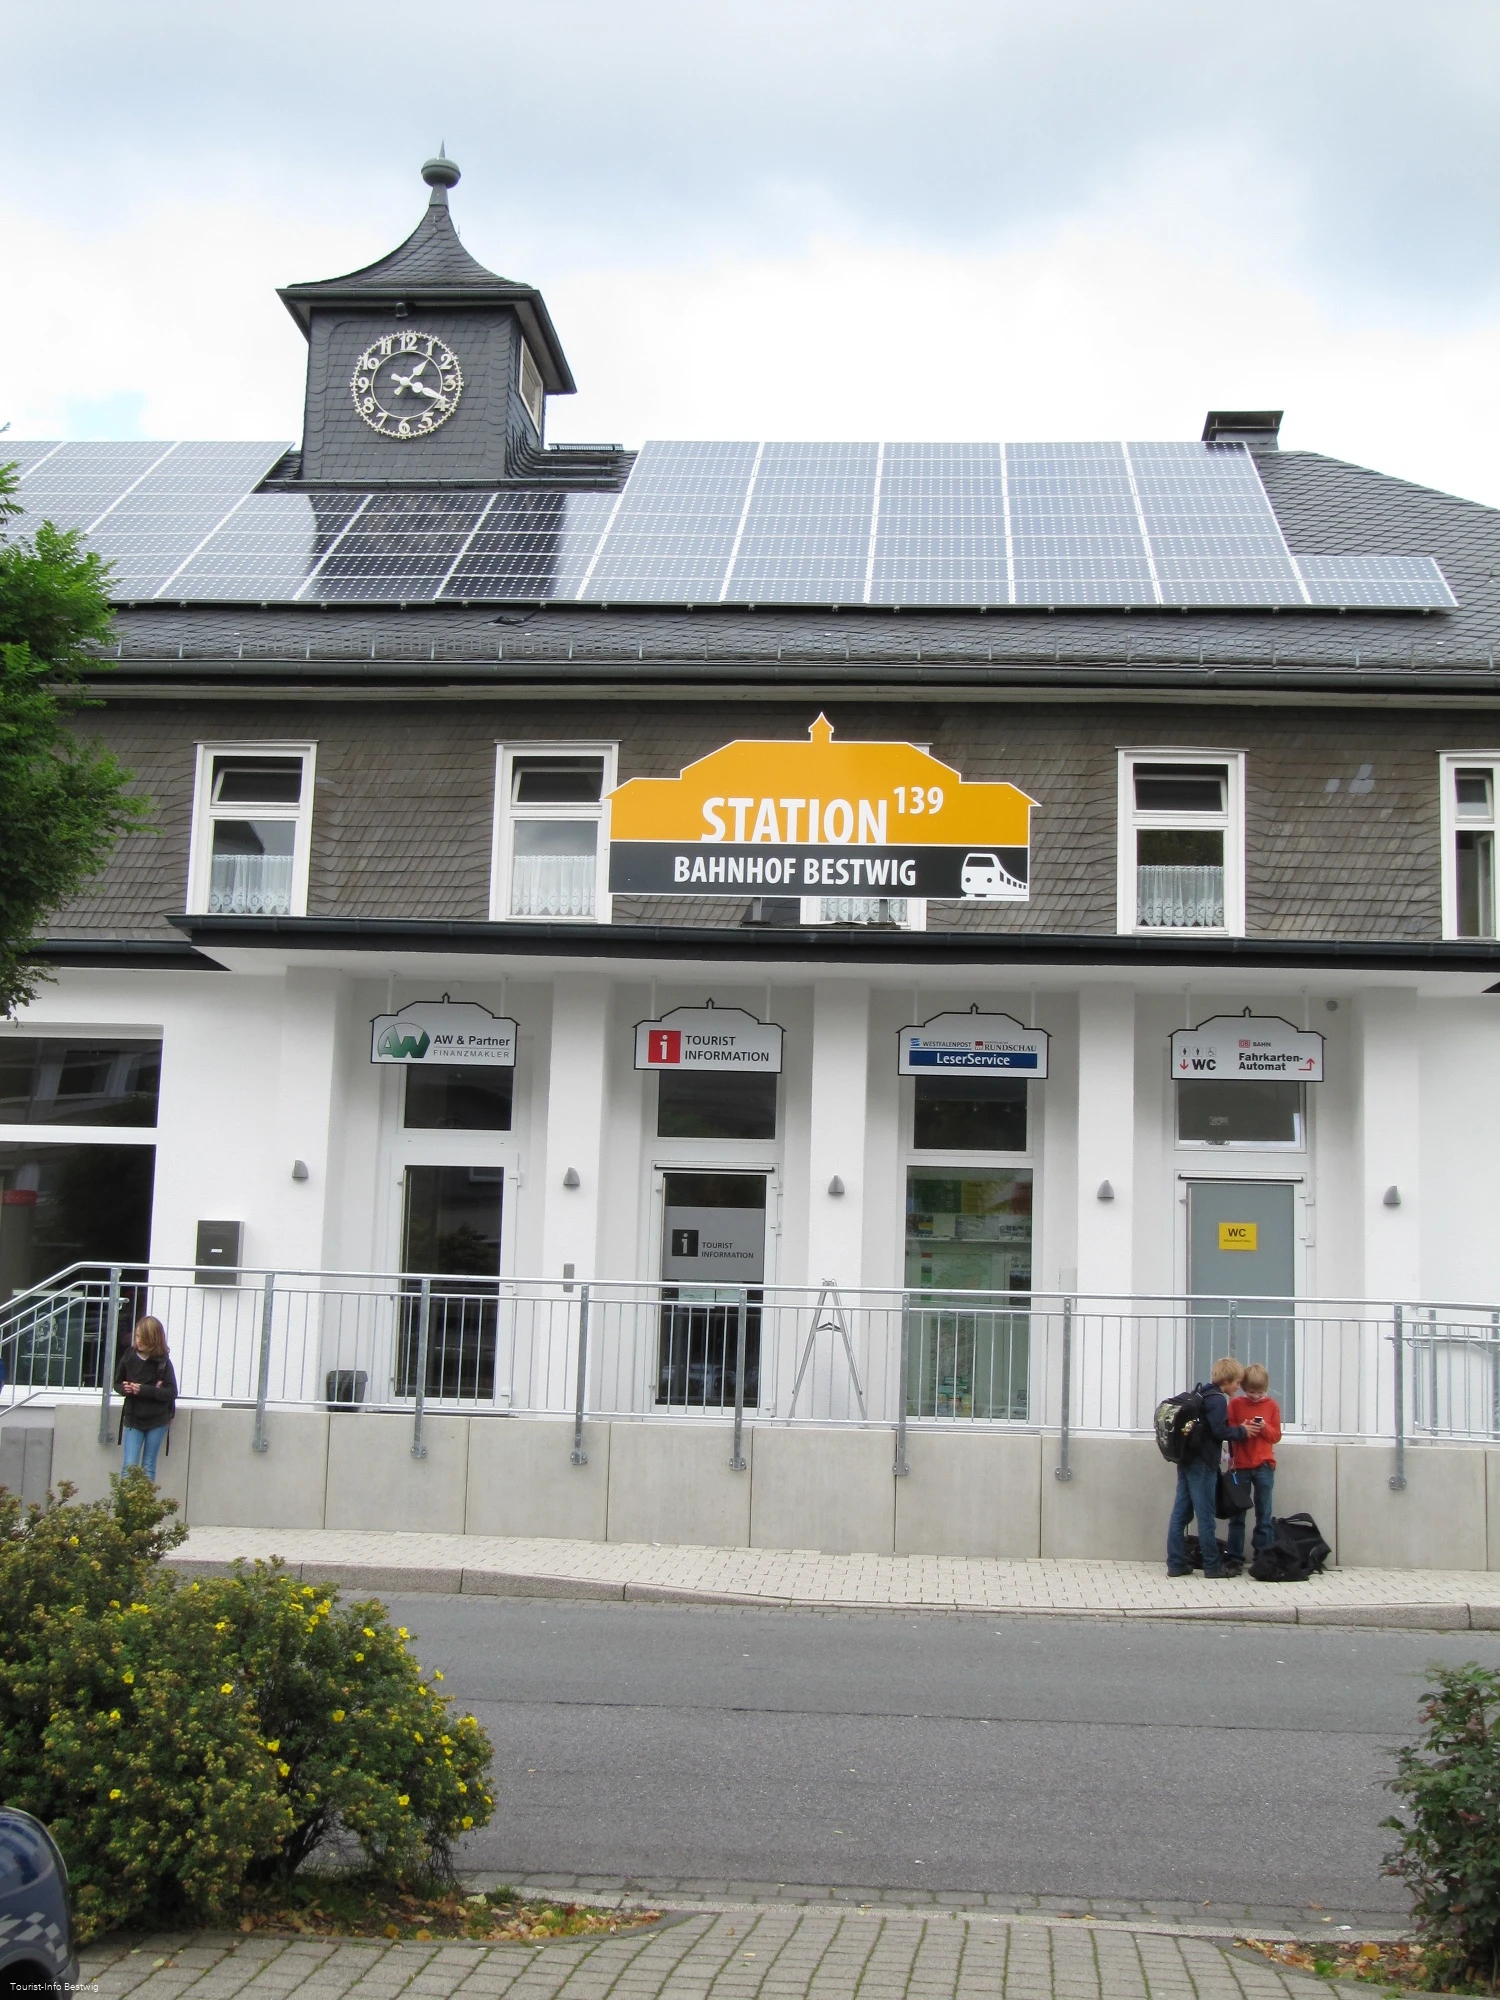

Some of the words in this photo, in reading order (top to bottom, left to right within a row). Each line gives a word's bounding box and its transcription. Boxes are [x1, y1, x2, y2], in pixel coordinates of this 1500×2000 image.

[380, 339, 393, 355] 11
[400, 335, 418, 351] 12
[426, 341, 435, 356] 1
[362, 354, 380, 370] 10
[440, 353, 453, 370] 2
[357, 376, 370, 393] 9
[442, 375, 457, 392] 3
[362, 397, 375, 414] 8
[434, 395, 450, 412] 4
[376, 412, 389, 429] 7
[398, 417, 411, 435] 6
[417, 412, 435, 429] 5
[701, 797, 888, 844] STATION
[893, 786, 944, 815] 139
[674, 856, 796, 884] BAHNHOF
[804, 858, 916, 886] BESTWIG
[434, 1035, 453, 1045] AW
[456, 1036, 465, 1045] &
[468, 1036, 511, 1046] Partner
[660, 1034, 668, 1060] i
[685, 1035, 736, 1046] TOURIST
[984, 1044, 1036, 1052] RUNDSCHAU
[1239, 1039, 1251, 1048] DB
[433, 1050, 510, 1058] FINANZMAKLER
[685, 1050, 769, 1062] INFORMATION
[936, 1053, 1010, 1066] LeserService
[1239, 1053, 1303, 1062] Fahrkarten-
[1192, 1059, 1216, 1071] WC
[1239, 1062, 1286, 1071] Automat
[1227, 1228, 1246, 1237] WC
[702, 1241, 733, 1249] TOURIST
[701, 1251, 754, 1259] INFORMATION
